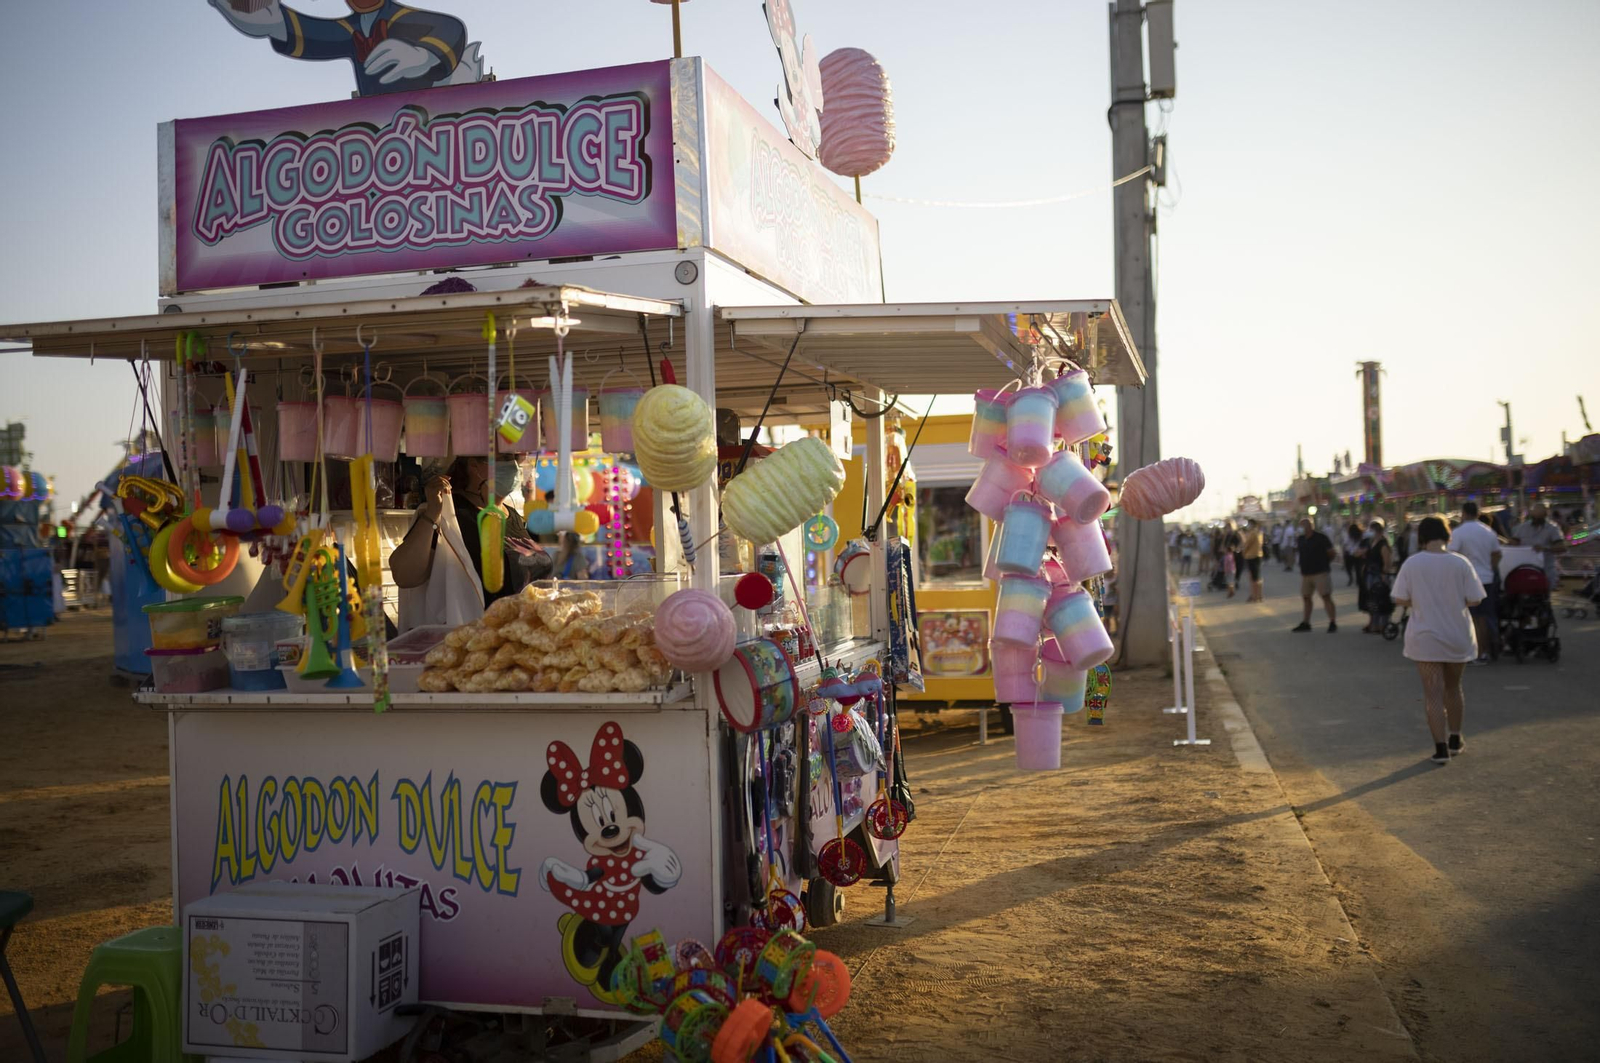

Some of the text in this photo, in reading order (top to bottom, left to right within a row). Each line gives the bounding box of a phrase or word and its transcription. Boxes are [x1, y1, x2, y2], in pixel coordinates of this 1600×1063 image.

[198, 101, 642, 238] ALGODÓN DULCE
[278, 189, 549, 253] GOLOSINAS
[210, 769, 379, 894] ALGODON
[391, 769, 521, 897] DULCE
[268, 968, 276, 976] de
[270, 982, 319, 995] 5 Sabores
